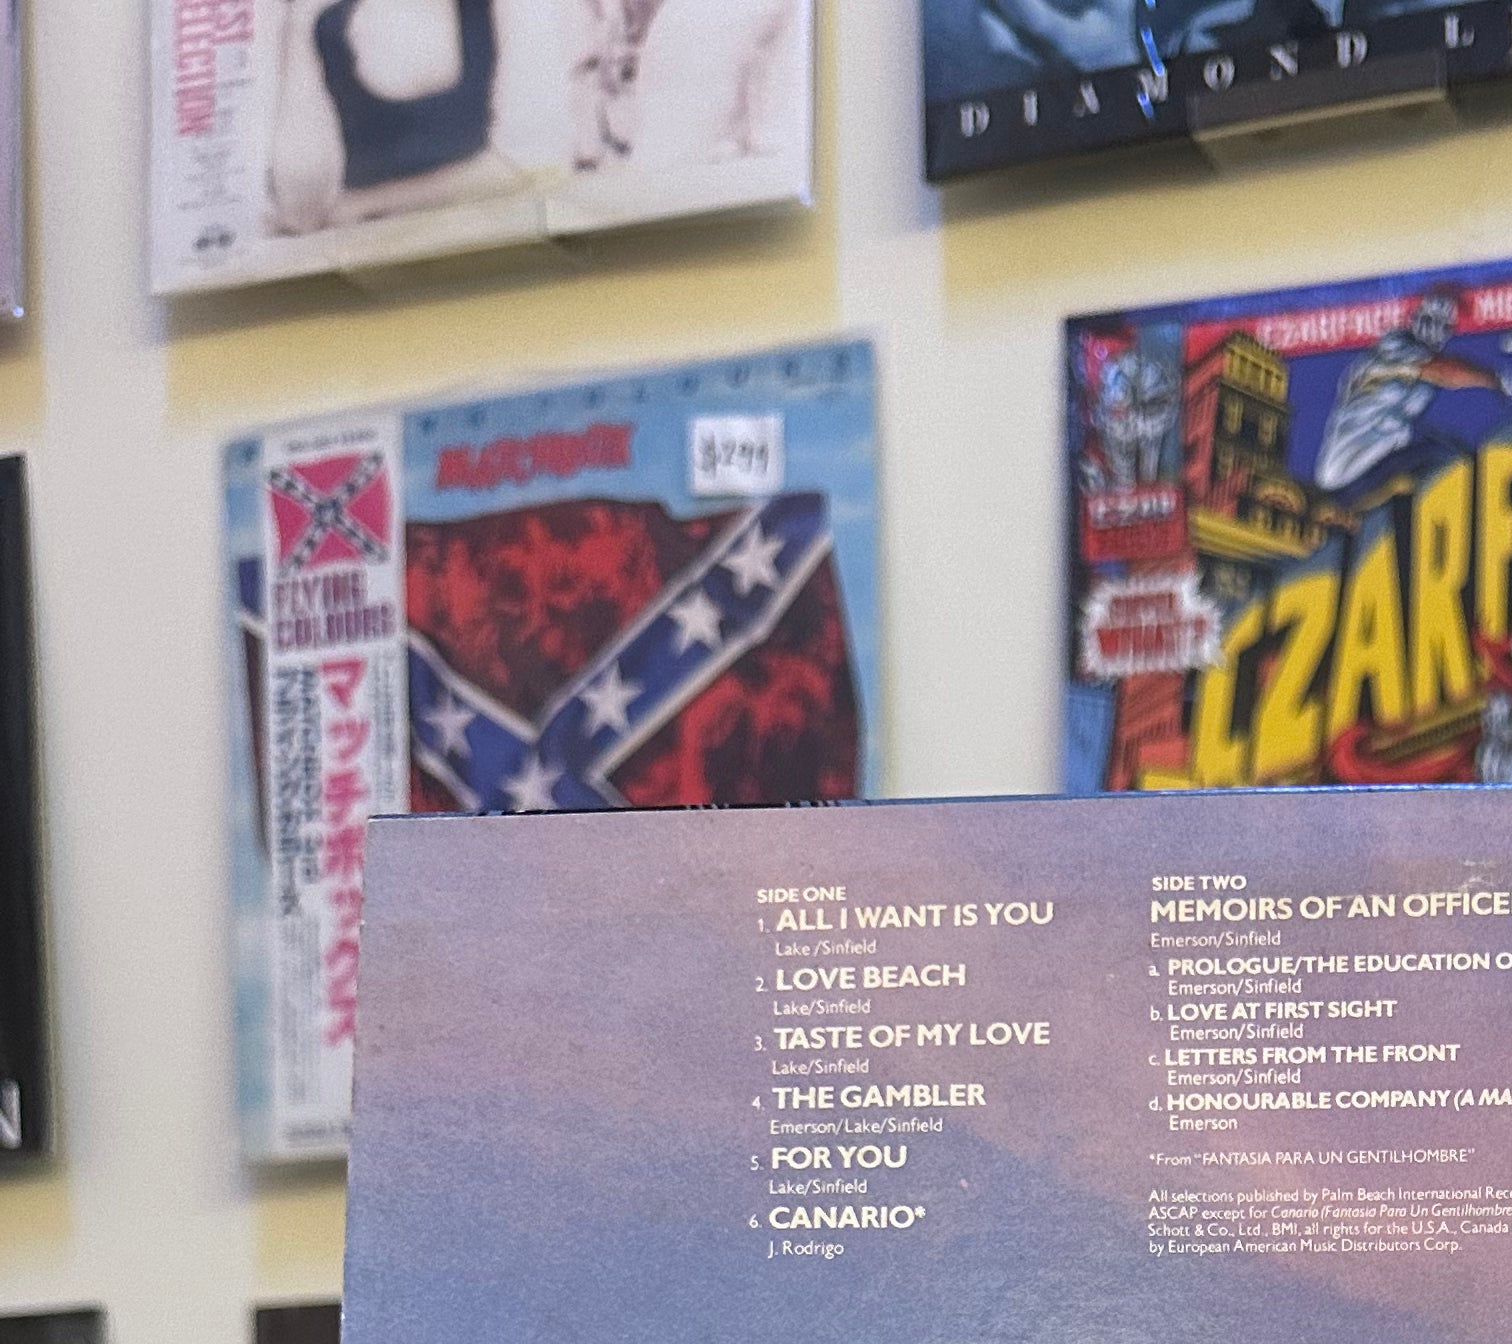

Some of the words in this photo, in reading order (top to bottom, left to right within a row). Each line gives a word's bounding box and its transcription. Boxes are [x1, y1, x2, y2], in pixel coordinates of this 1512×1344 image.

[959, 30, 1369, 139] DIAMOND
[1152, 876, 1194, 891] SIDE
[1200, 875, 1247, 890] TWO
[757, 889, 798, 904] SIDE
[803, 887, 846, 902] ONE
[776, 908, 832, 931] ALL
[841, 907, 847, 929] I
[855, 905, 947, 928] WANT
[954, 904, 978, 926] IS
[985, 902, 1054, 926] YOU
[1151, 898, 1293, 923] MEMOIRS
[1300, 897, 1343, 920] OF
[1348, 895, 1396, 919] AN
[1151, 931, 1281, 948] Emerson/Sinfield
[1169, 956, 1348, 976] PROLOGUE/THE
[1354, 953, 1490, 972] EDUCATION
[776, 968, 856, 991] LOVE
[864, 964, 966, 988] BEACH
[1169, 979, 1302, 996] Emerson/Sinfield
[773, 1000, 871, 1016] Lake/Sinfield
[1151, 1007, 1164, 1021] b.
[1168, 1004, 1227, 1021] LOVE
[1231, 1003, 1261, 1020] AT
[1265, 1001, 1324, 1019] FIRST
[1328, 1000, 1397, 1018] SIGHT
[774, 1027, 862, 1050] TASTE
[869, 1025, 910, 1048] OF
[917, 1024, 962, 1046] MY
[970, 1022, 1050, 1046] LOVE
[1170, 1024, 1303, 1040] Emerson/Sinfield
[1165, 1048, 1257, 1066] LETTERS
[1262, 1047, 1326, 1064] FROM
[1331, 1046, 1377, 1063] THE
[1383, 1044, 1460, 1062] FRONT
[772, 1059, 869, 1075] Lake/Sinfield
[1168, 1069, 1301, 1086] Emerson/Sinfield
[773, 1086, 834, 1109] THE
[841, 1084, 986, 1108] GAMBLER
[1149, 1098, 1162, 1111] d.
[1167, 1092, 1331, 1111] HONOURABLE
[1335, 1090, 1450, 1108] COMPANY
[1454, 1090, 1474, 1111] (A
[770, 1118, 943, 1135] Emerson/Lake/Sinfield
[1169, 1116, 1238, 1131] Emerson
[772, 1146, 831, 1169] FOR
[837, 1145, 907, 1168] YOU
[769, 1180, 867, 1195] Lake/Sinfield
[768, 1241, 779, 1259] J.
[782, 1240, 844, 1259] Rodrigo
